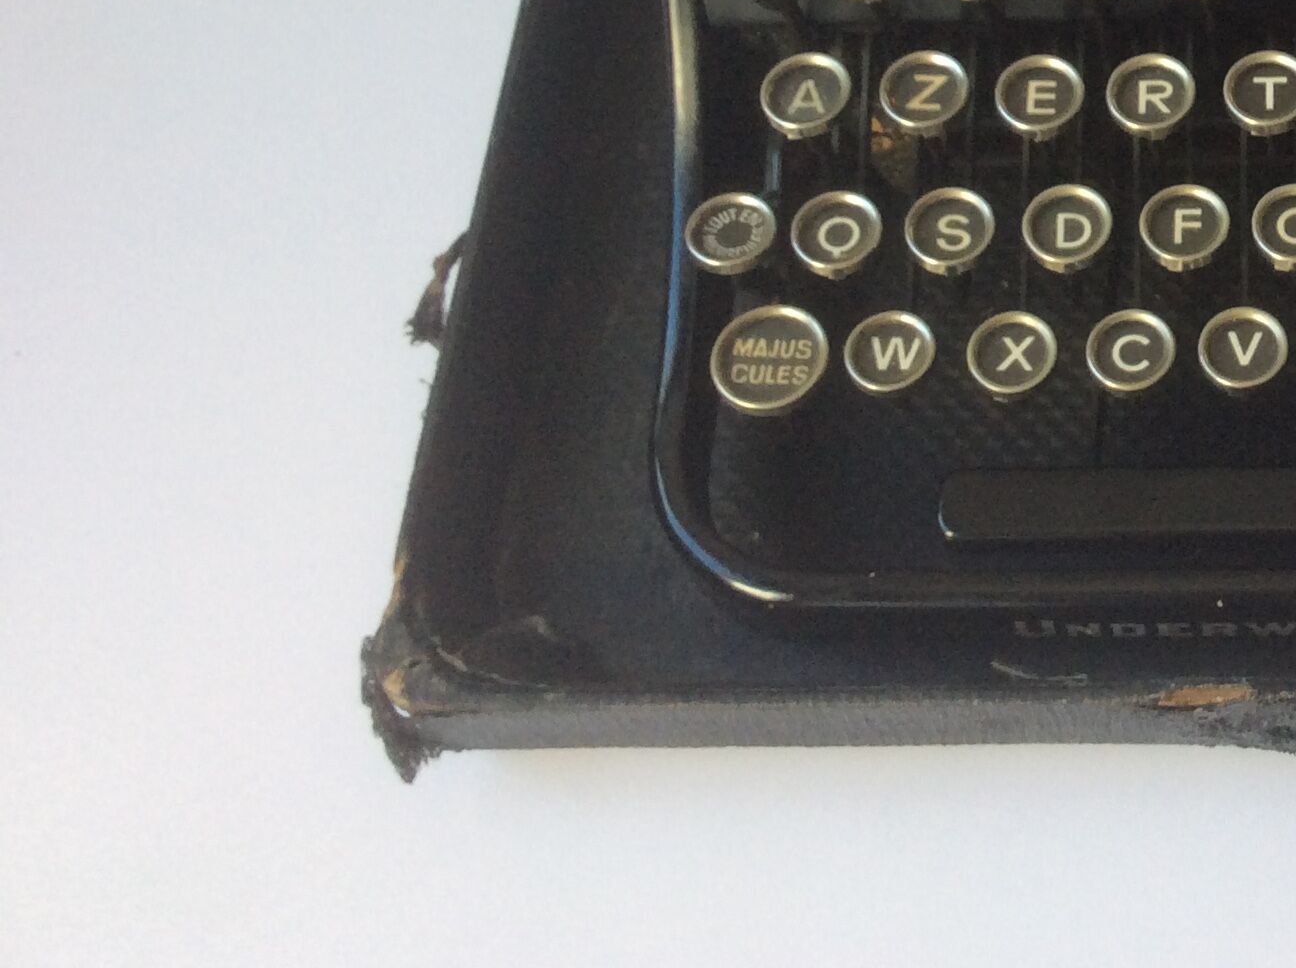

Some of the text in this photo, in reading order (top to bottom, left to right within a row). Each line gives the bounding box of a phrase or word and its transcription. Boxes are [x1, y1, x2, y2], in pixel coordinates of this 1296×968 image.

[787, 78, 826, 113] A
[905, 73, 949, 112] Z
[1026, 80, 1058, 115] E
[1137, 79, 1173, 115] R
[1253, 75, 1288, 111] T
[935, 213, 972, 252] S
[1055, 213, 1092, 248] D
[1173, 208, 1202, 245] F
[732, 337, 813, 360] MAJUS
[870, 336, 921, 371] W
[996, 335, 1036, 372] X
[1112, 334, 1151, 372] C
[1227, 331, 1264, 367] V
[731, 363, 810, 386] CULES
